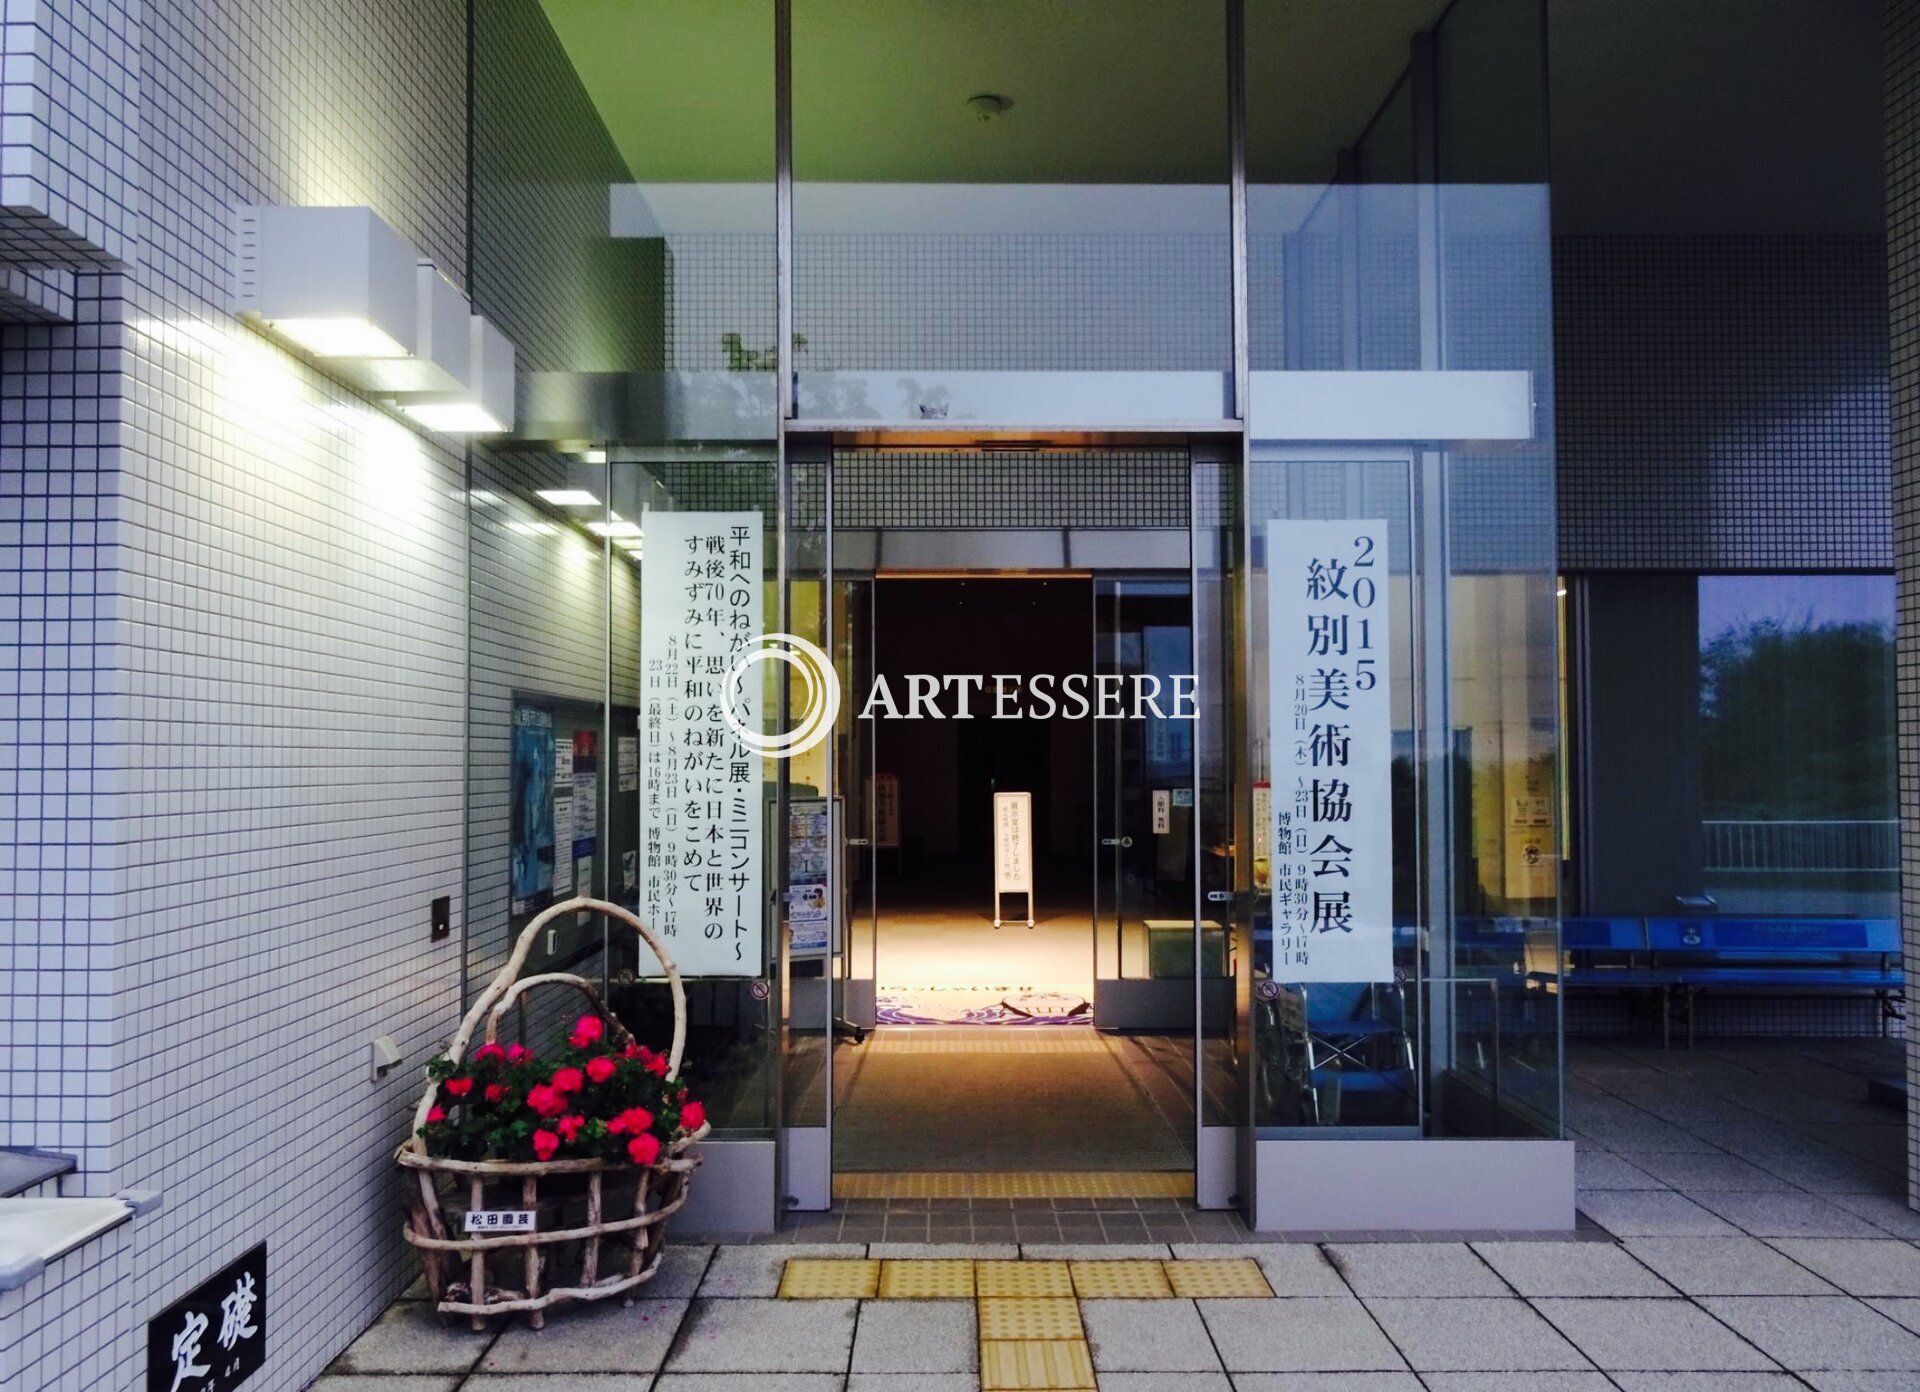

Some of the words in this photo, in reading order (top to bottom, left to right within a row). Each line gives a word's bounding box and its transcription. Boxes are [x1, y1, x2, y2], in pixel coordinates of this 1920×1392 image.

[1353, 536, 1376, 690] 2015
[684, 535, 703, 892] すみずみに平和のねがいをこめて
[1306, 558, 1353, 934] 紋別美術協会展
[648, 827, 661, 867] 博物館
[1278, 812, 1292, 855] 博物館
[1279, 864, 1293, 965] 市民ギャラリー
